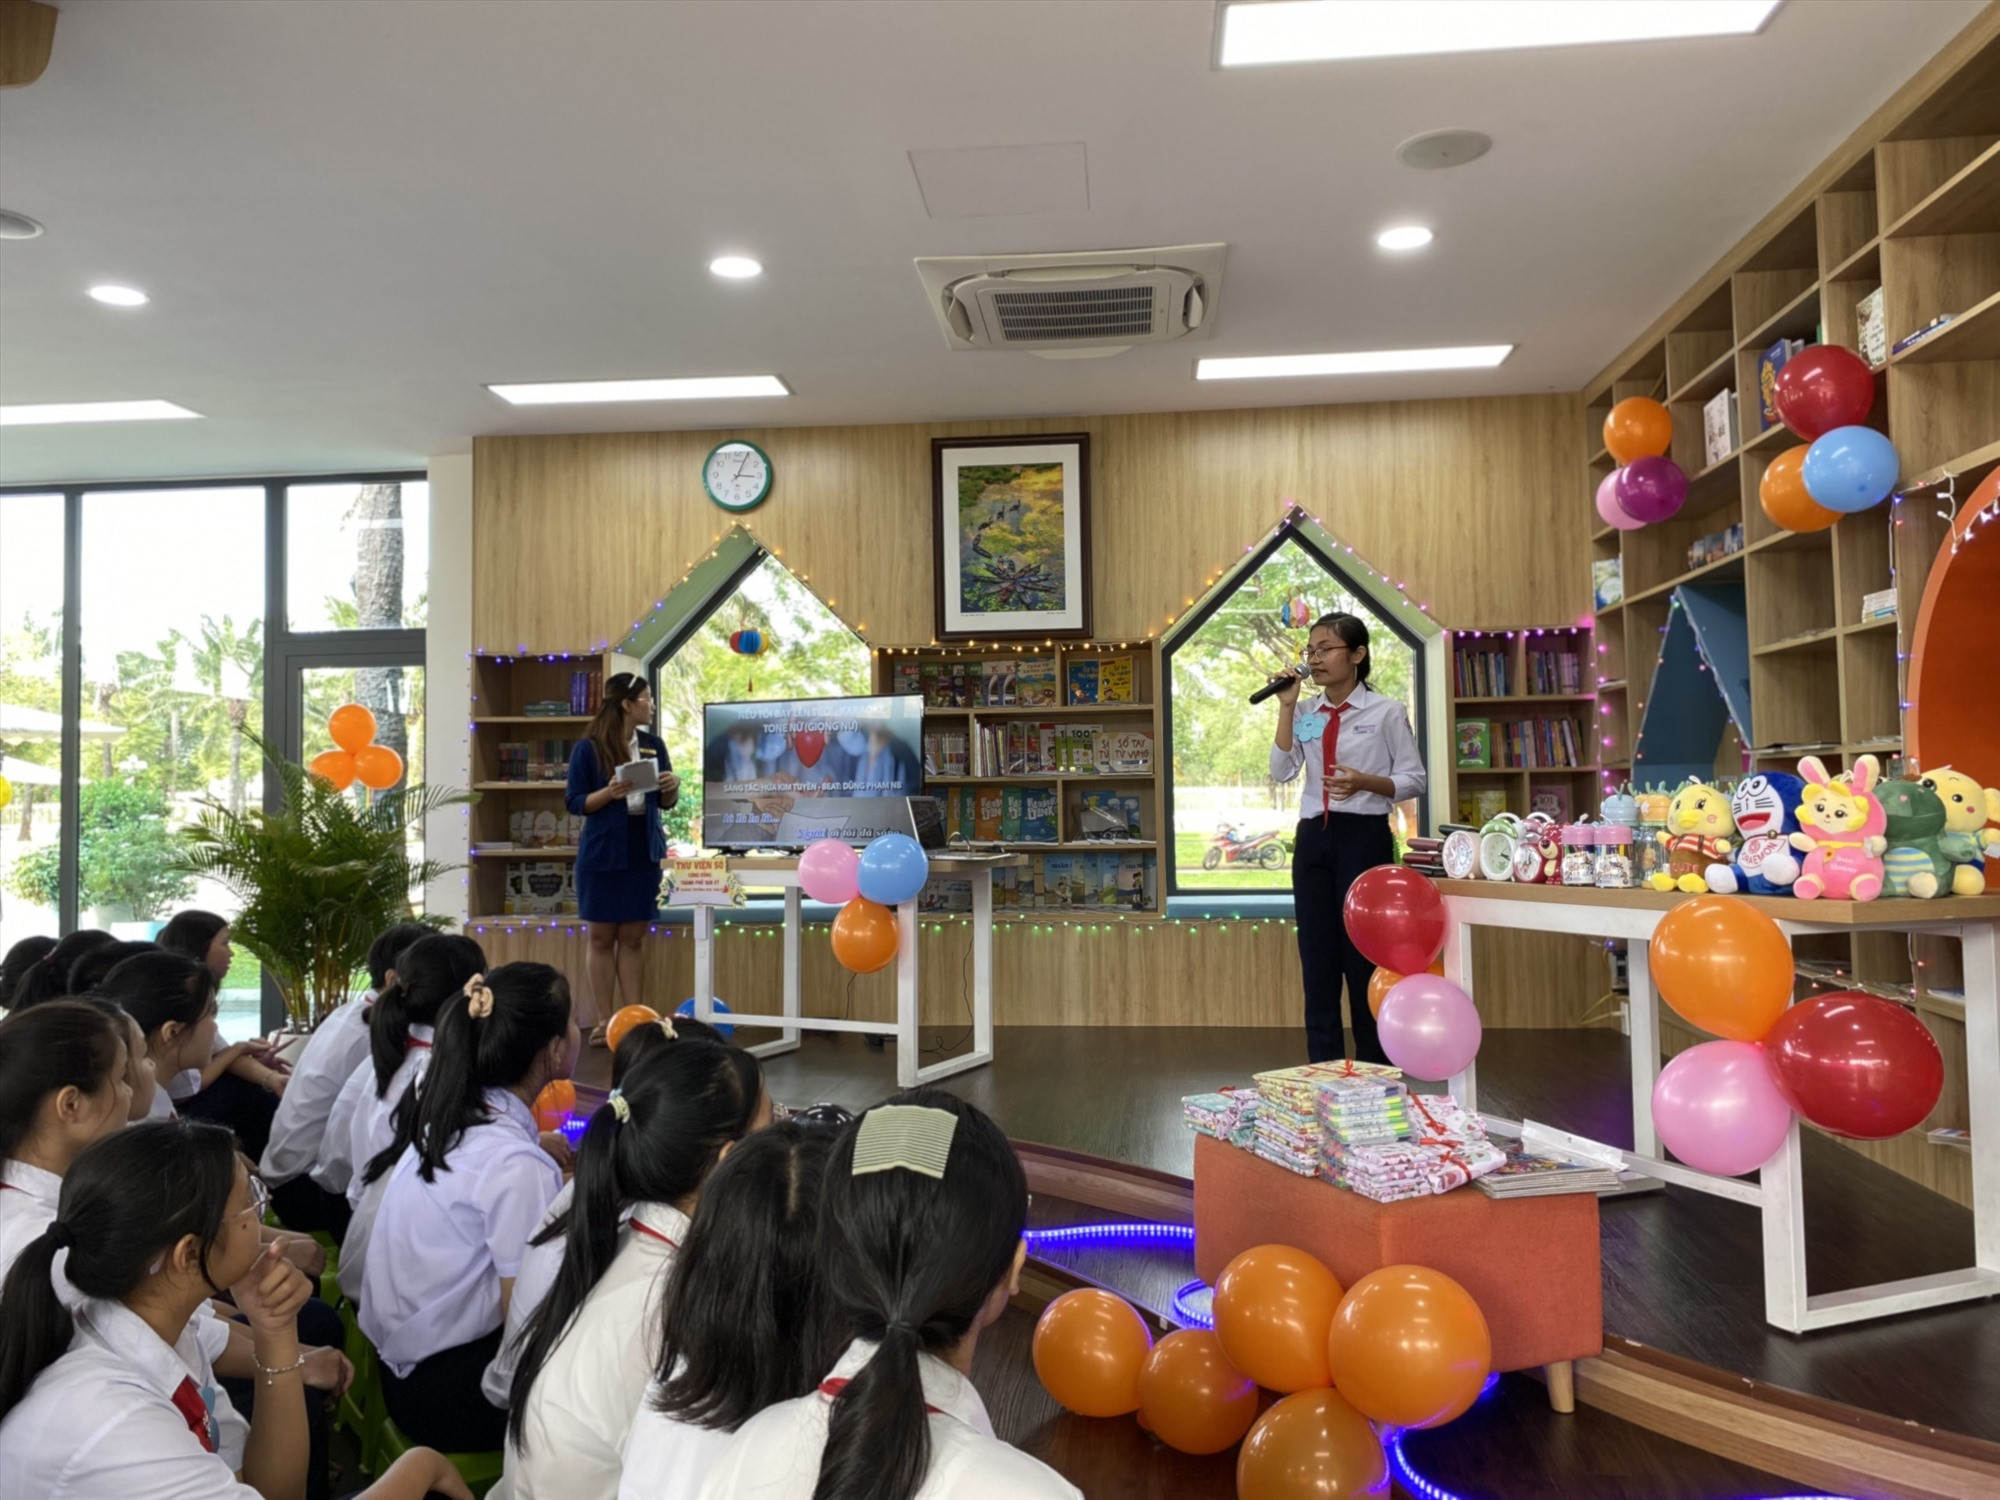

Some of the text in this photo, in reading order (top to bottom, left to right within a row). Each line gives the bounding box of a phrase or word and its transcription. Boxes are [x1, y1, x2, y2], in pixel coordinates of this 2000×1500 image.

[753, 460, 759, 468] 2
[713, 471, 719, 479] 9
[763, 724, 788, 734] TONE
[822, 782, 842, 791] BEAT:
[890, 781, 902, 790] NB
[1672, 862, 1699, 873] CUTE
